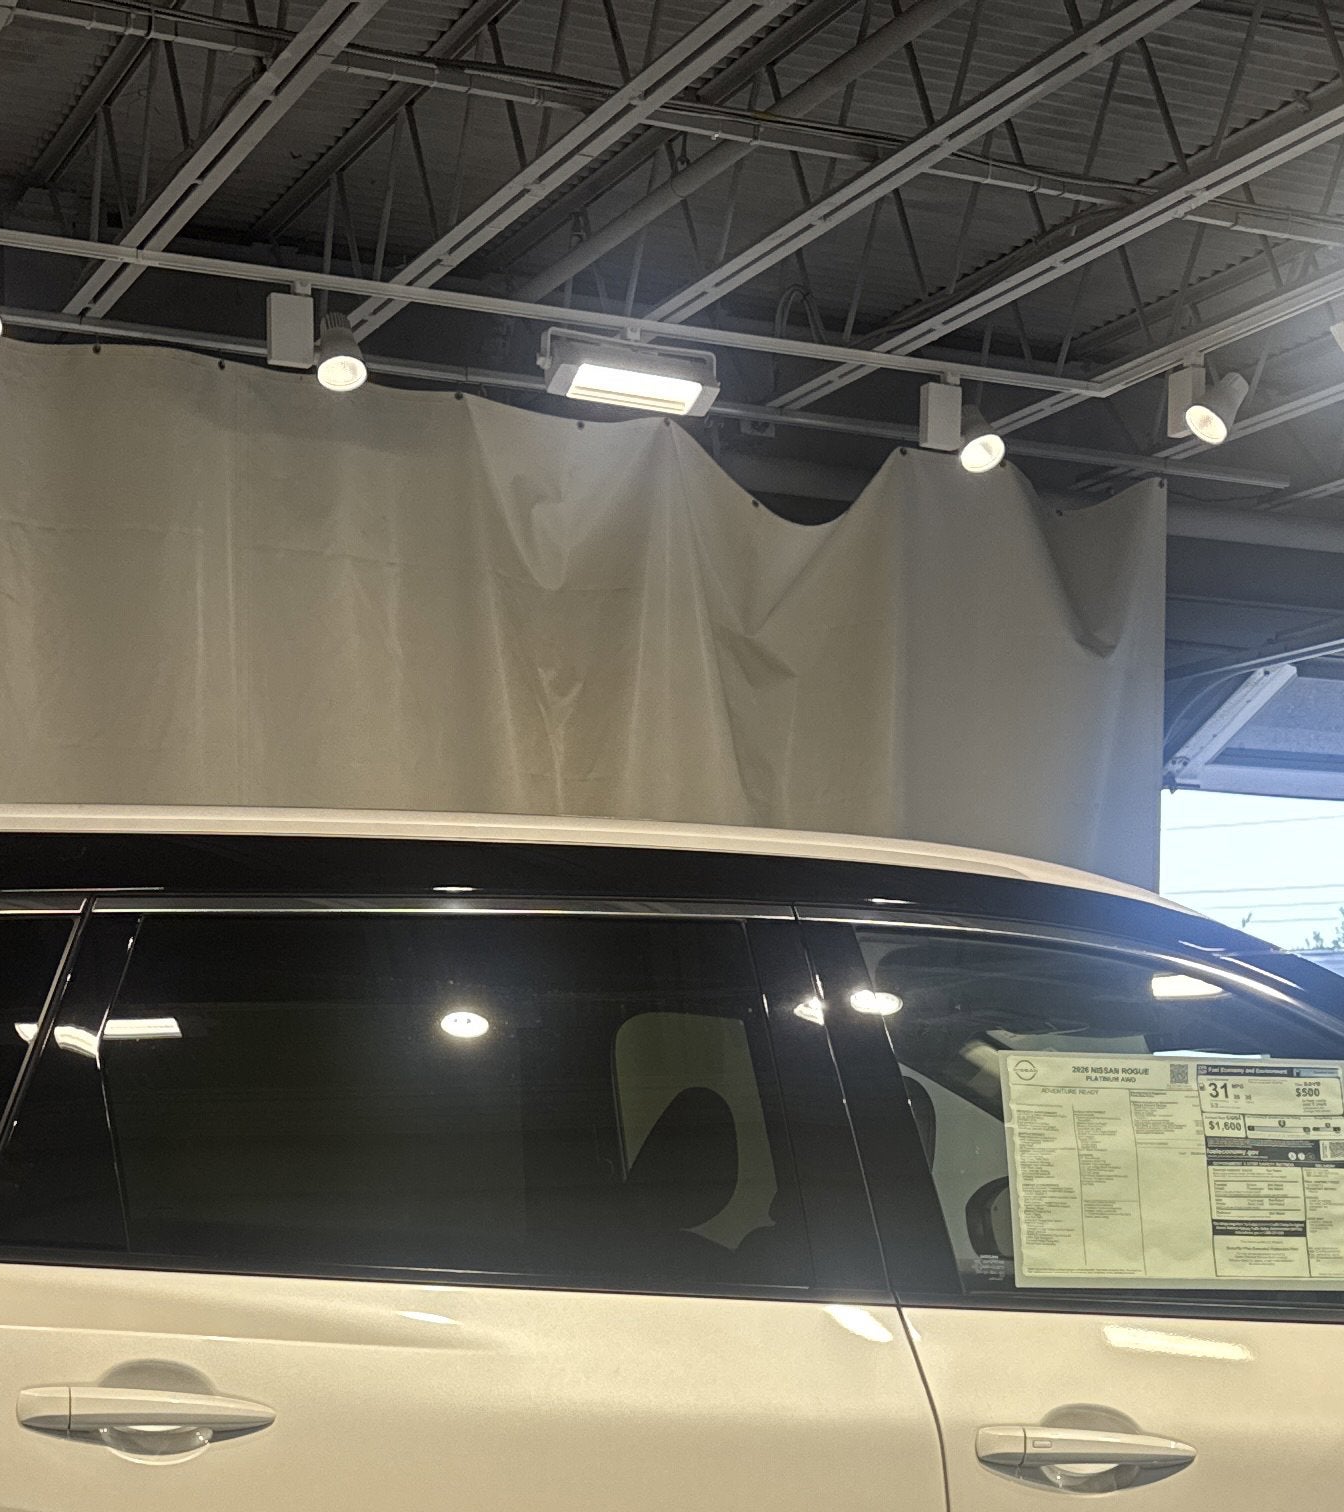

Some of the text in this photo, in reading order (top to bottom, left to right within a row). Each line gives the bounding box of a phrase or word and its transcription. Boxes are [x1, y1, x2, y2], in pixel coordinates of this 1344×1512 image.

[1091, 1066, 1119, 1075] NISSAN
[1122, 1067, 1150, 1076] ROGUE
[1086, 1075, 1137, 1084] PLATINUM AWD
[1208, 1082, 1229, 1099] 31
[1295, 1087, 1320, 1098] $500
[1208, 1120, 1242, 1131] $1,600
